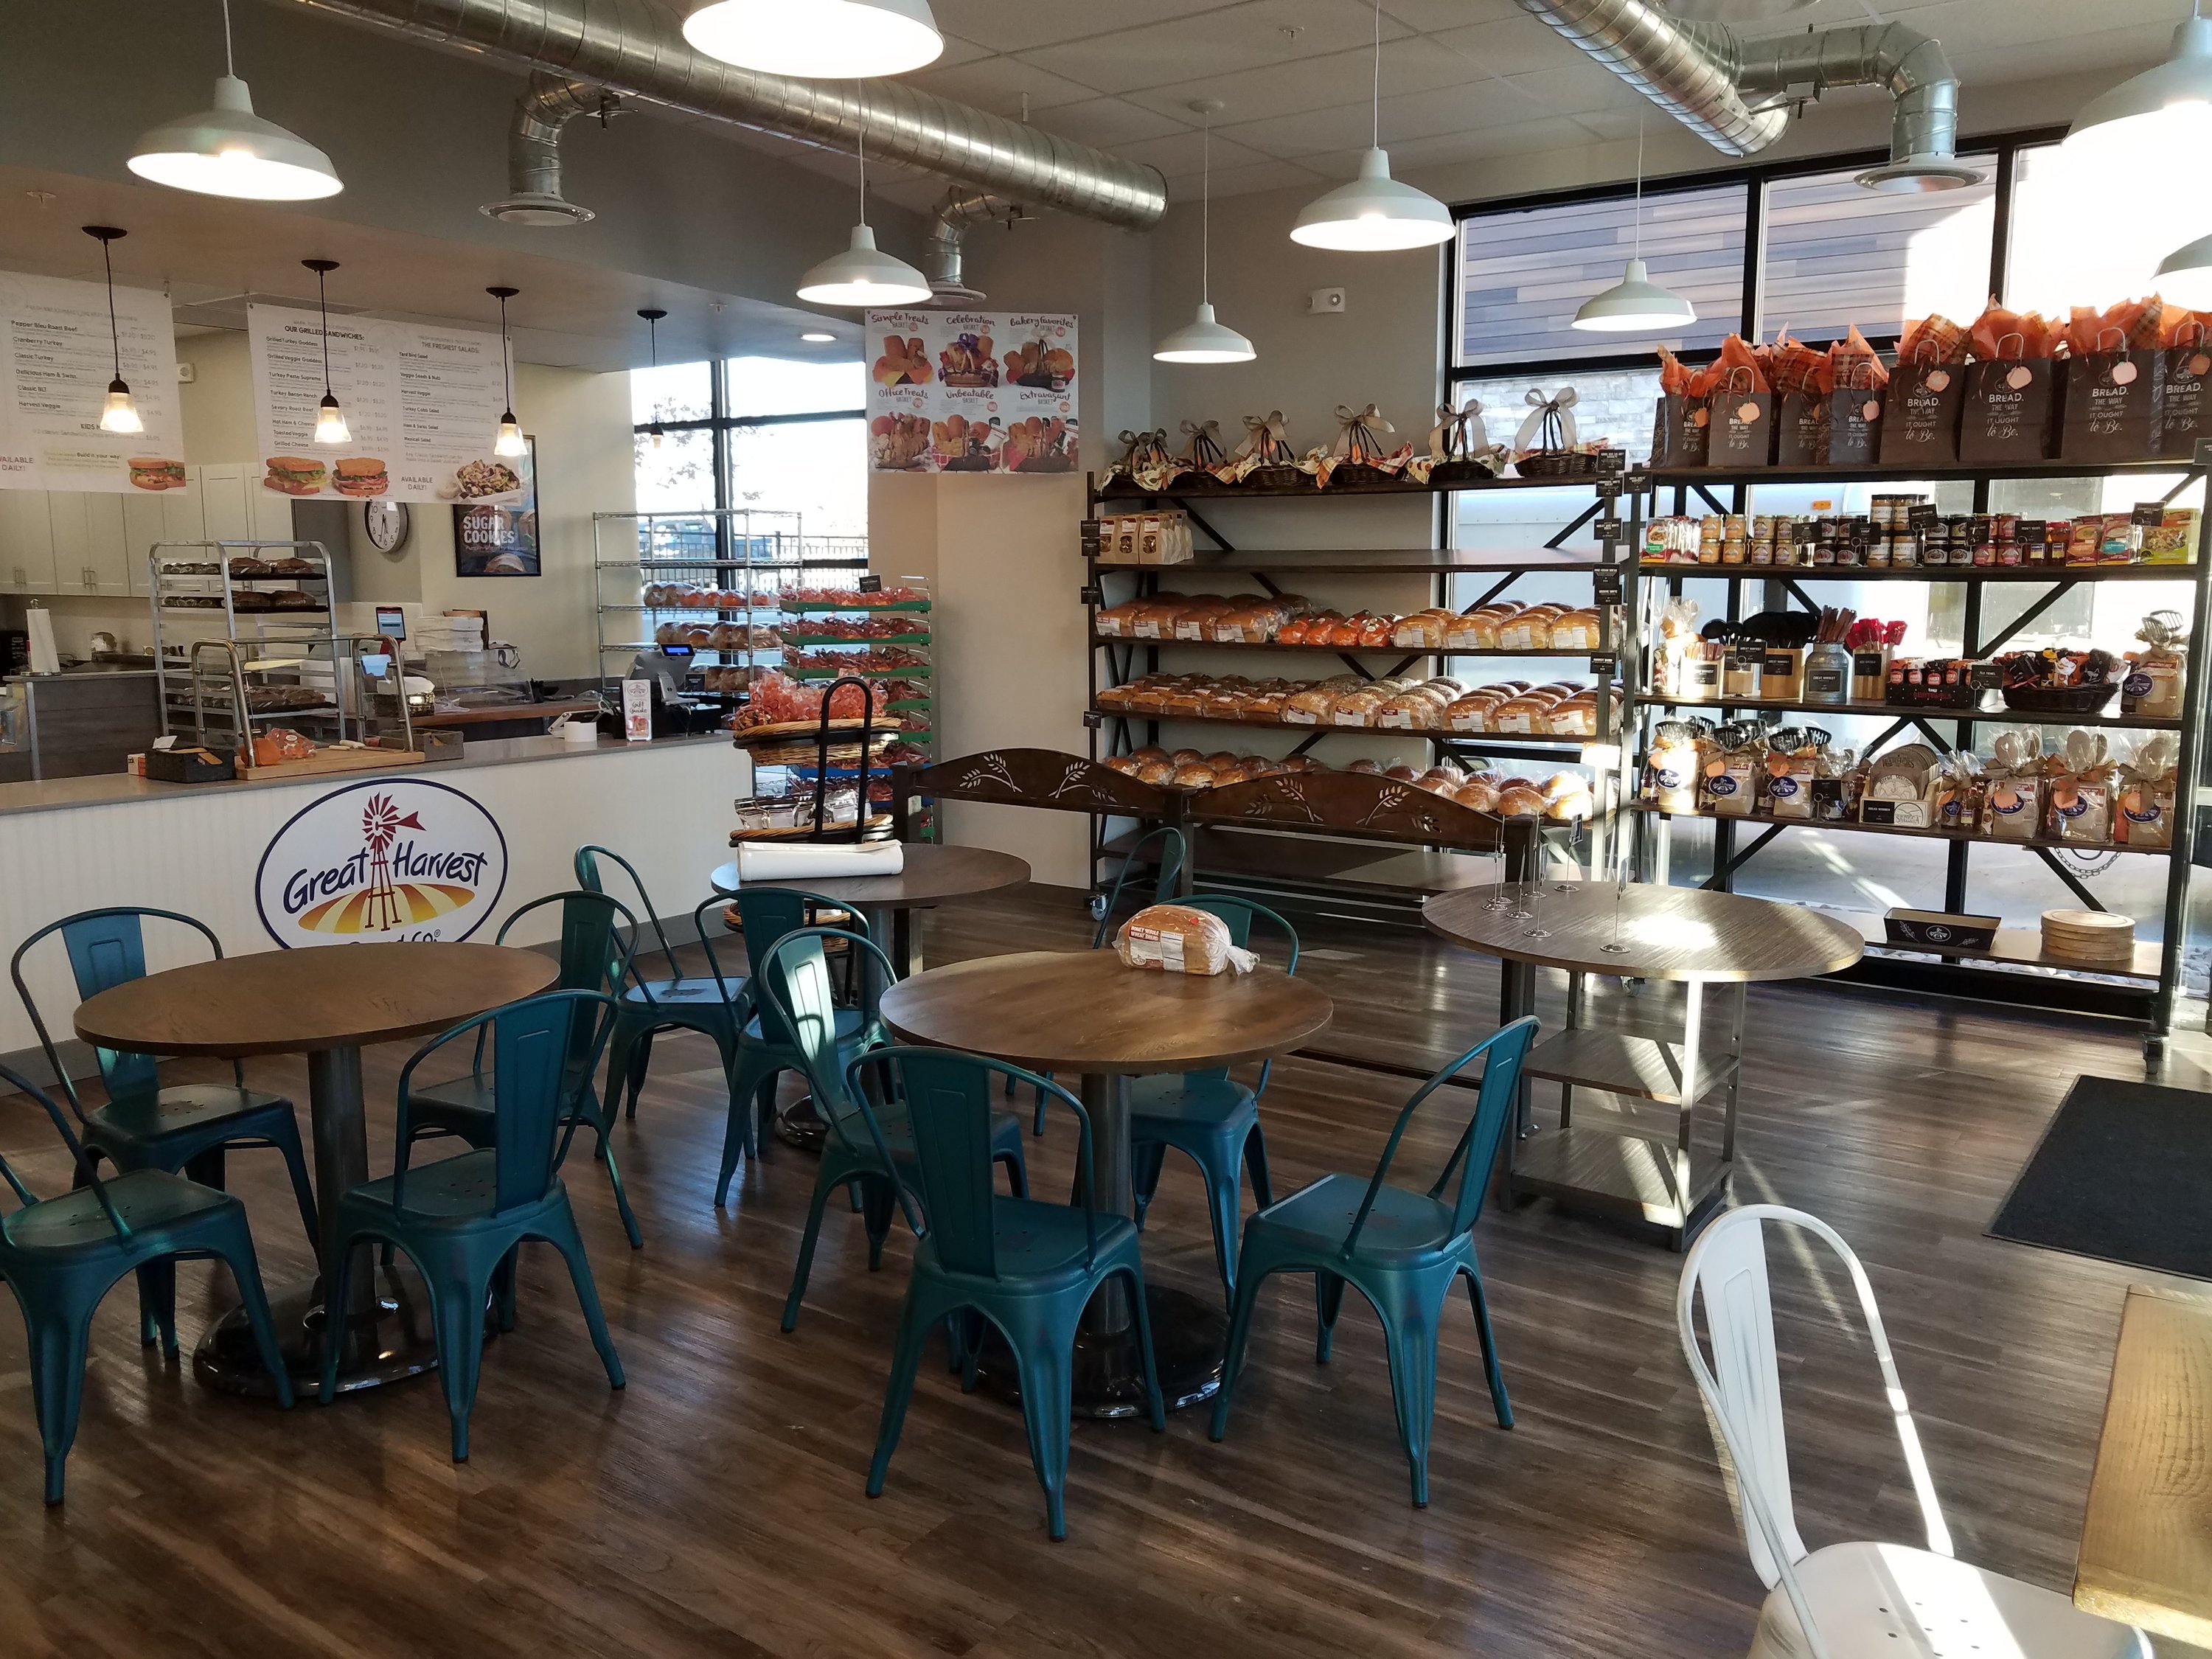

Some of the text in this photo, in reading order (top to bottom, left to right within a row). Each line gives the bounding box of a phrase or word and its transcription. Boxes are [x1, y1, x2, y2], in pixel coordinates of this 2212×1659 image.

[872, 312, 929, 324] Simple Treats
[946, 314, 995, 326] Celebration
[1010, 316, 1040, 327] Bakery
[11, 320, 33, 328] Pepper
[299, 327, 323, 335] GRILLED
[323, 330, 365, 341] SANDWICHES:
[13, 336, 63, 347] Cranberry Turkey
[432, 343, 457, 351] FRESHEST
[34, 354, 54, 362] Turkey
[17, 384, 37, 392] Classic
[878, 387, 928, 399] Office Treats
[2092, 386, 2129, 397] BREAD.
[2166, 383, 2203, 394] BREAD.
[271, 390, 287, 398] Turkey
[946, 389, 994, 400] Unbeatable
[1020, 390, 1071, 403] Extravagant
[1989, 393, 2024, 403] BREAD.
[2090, 418, 2123, 434] to Be.
[2165, 415, 2198, 431] to Be.
[1905, 427, 1935, 442] to Be.
[1986, 424, 2018, 439] to Be.
[1728, 439, 1735, 448] to
[463, 515, 504, 529] SUGAR
[464, 530, 515, 544] COOKES
[283, 840, 488, 914] Great Harvest
[1130, 925, 1159, 936] HONEY WHOLE
